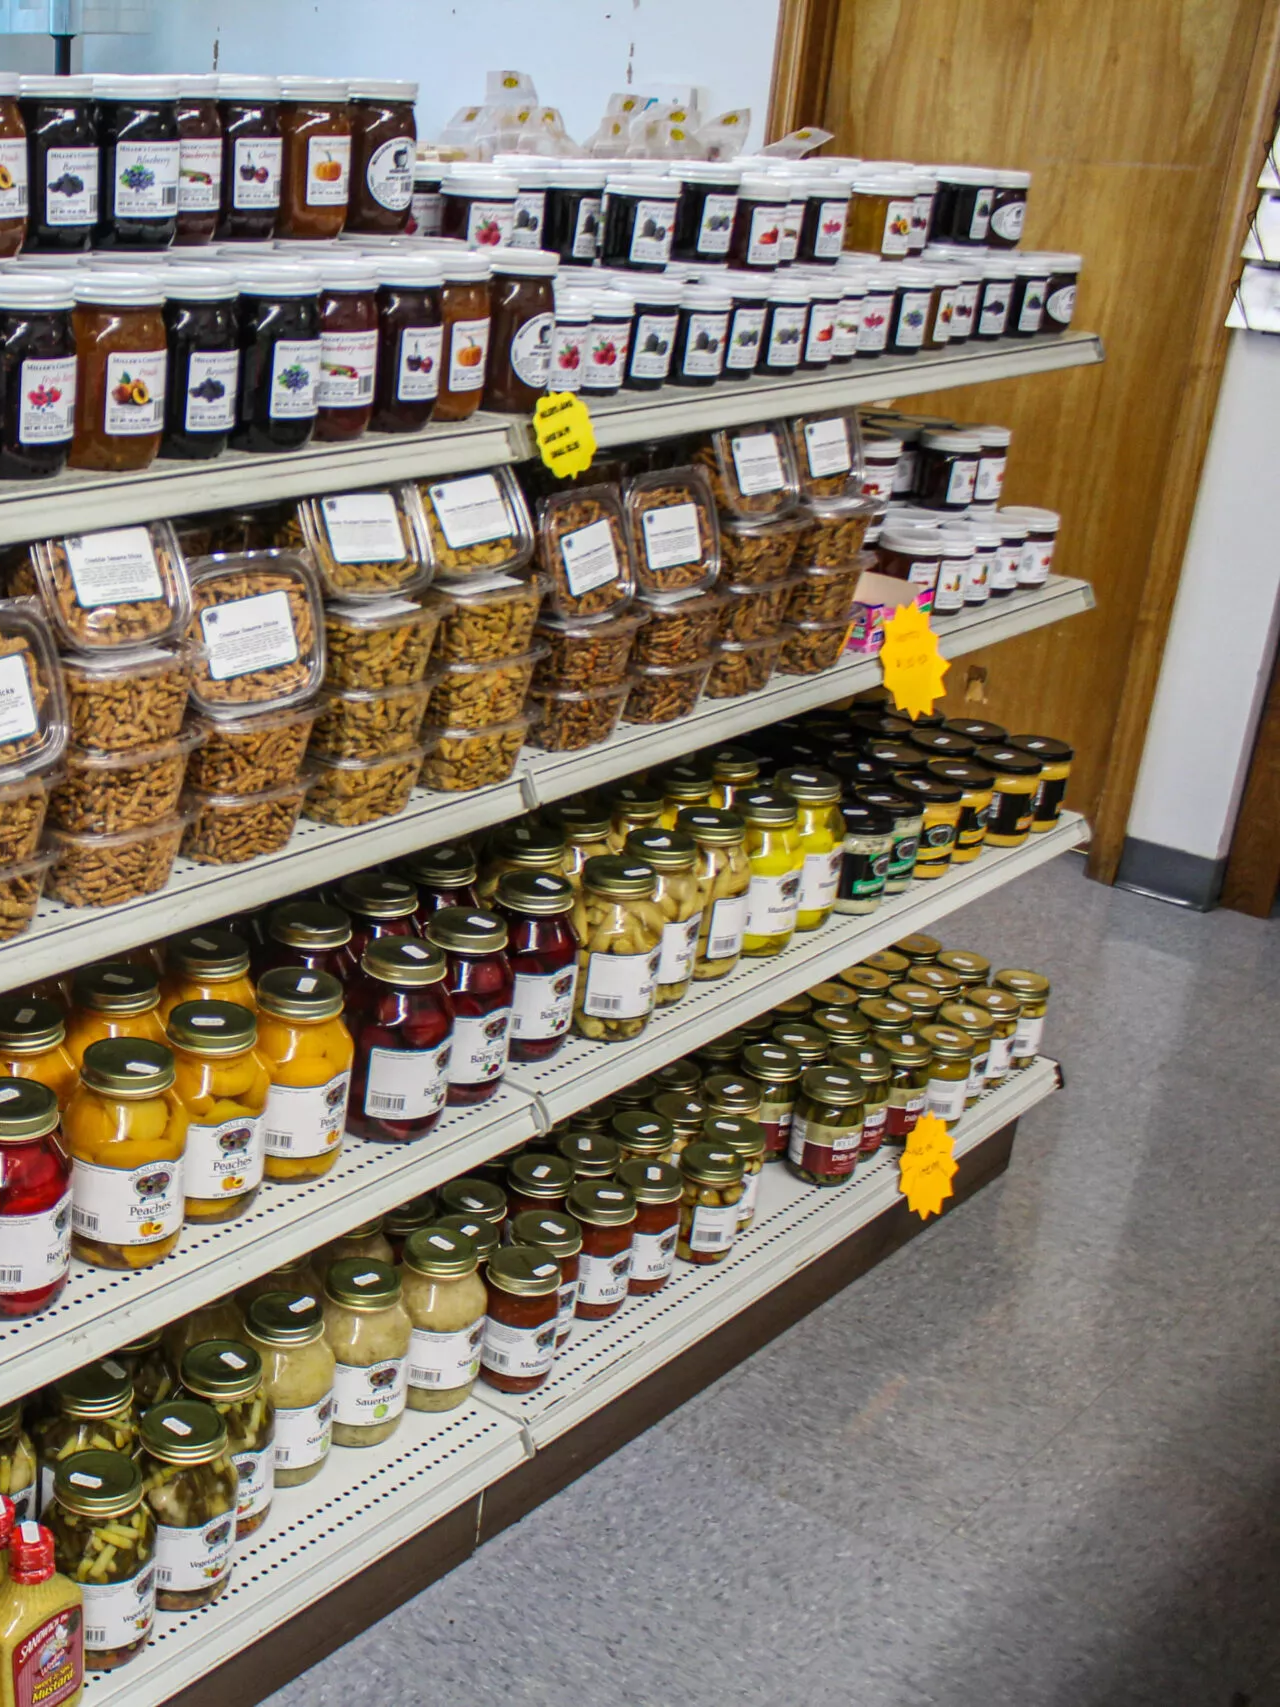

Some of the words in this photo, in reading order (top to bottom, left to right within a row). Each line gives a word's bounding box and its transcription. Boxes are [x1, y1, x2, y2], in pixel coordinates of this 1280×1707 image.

[136, 154, 171, 168] Blueberry
[540, 1008, 559, 1020] Baby
[471, 1053, 495, 1064] Baby
[213, 1156, 253, 1171] Peaches
[130, 1201, 171, 1216] Peaches
[647, 1261, 667, 1273] Mild
[599, 1286, 620, 1297] Mild
[355, 1391, 402, 1407] Sauerkraut
[190, 1550, 226, 1569] Vegetable
[19, 1619, 60, 1663] SANDWICH
[32, 1668, 76, 1704] Mustard
